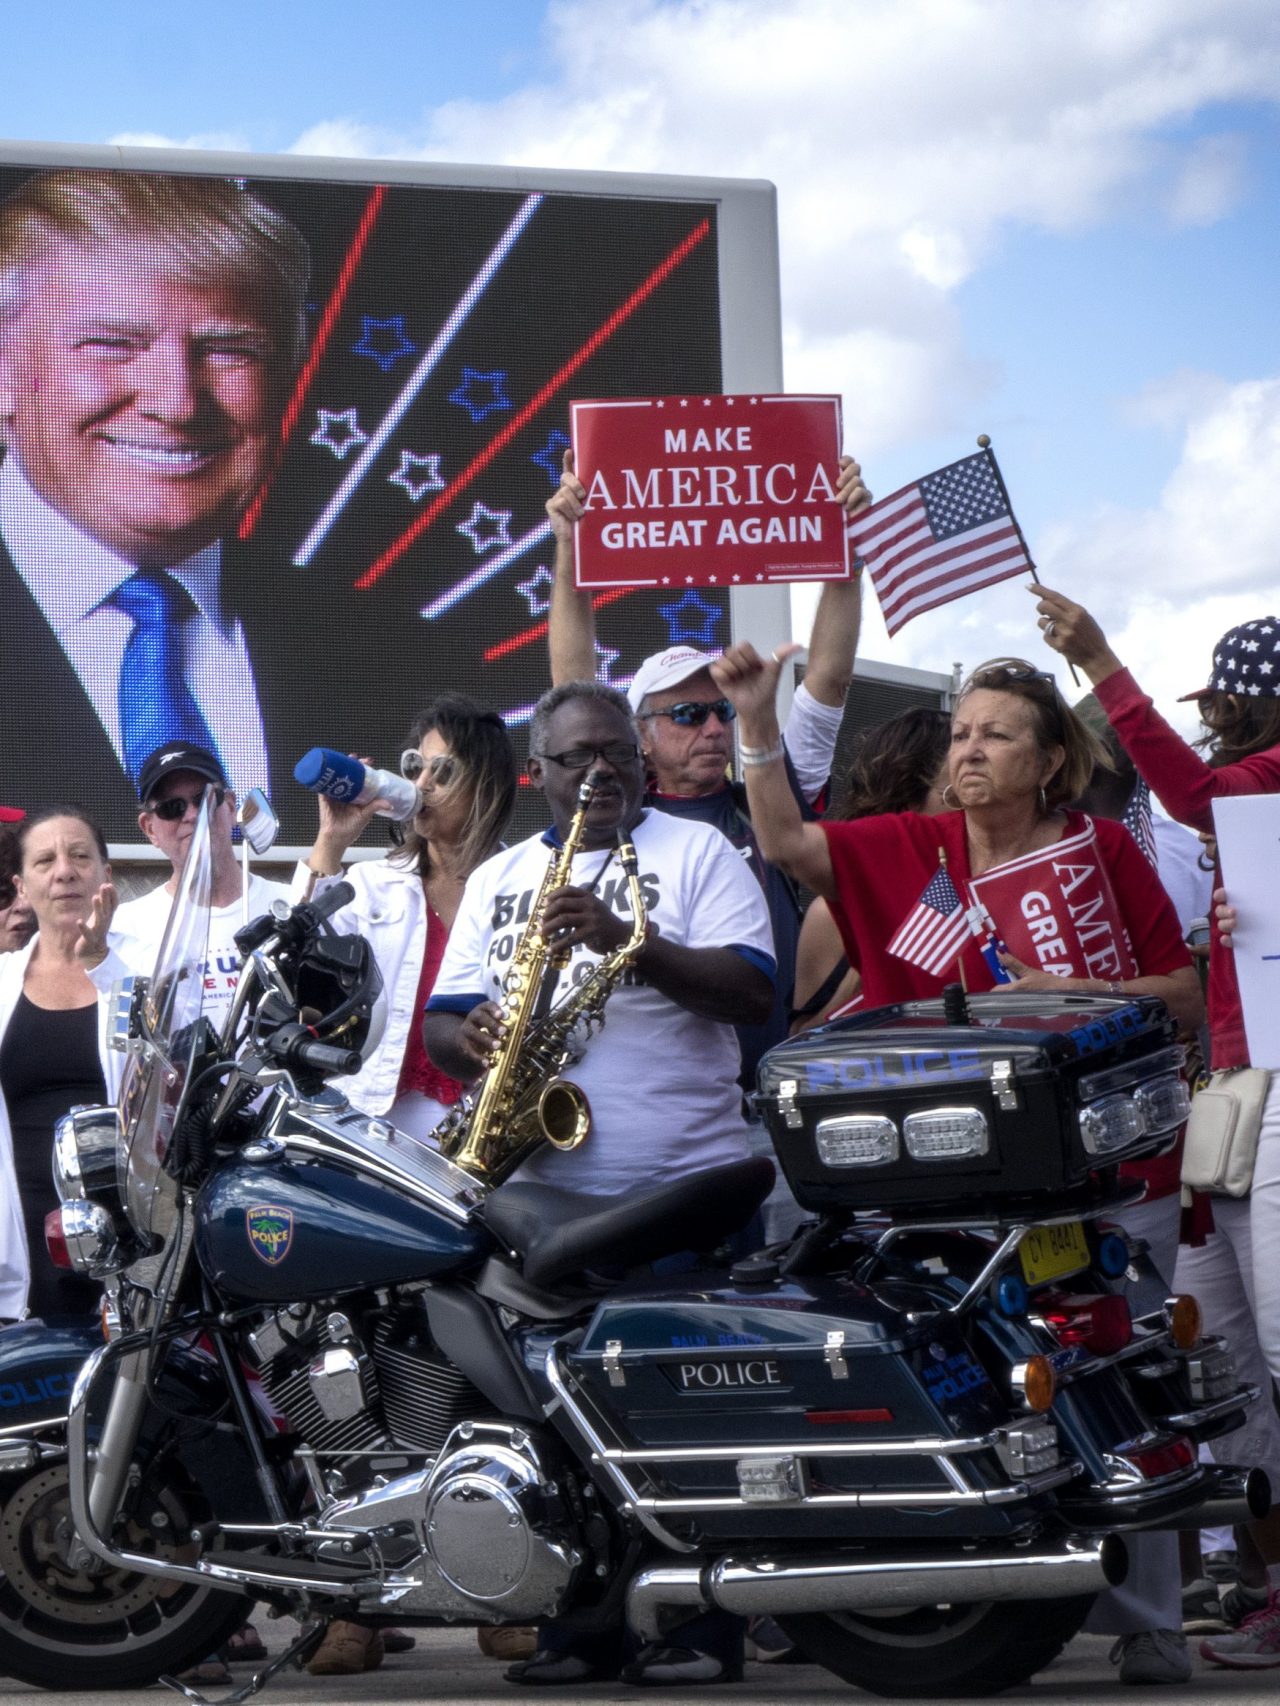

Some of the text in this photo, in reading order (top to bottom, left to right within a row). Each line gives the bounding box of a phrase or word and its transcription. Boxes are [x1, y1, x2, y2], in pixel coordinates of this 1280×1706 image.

[664, 426, 752, 453] MAKE
[583, 462, 840, 511] AMERICA
[600, 515, 822, 549] GREAT AGAIN
[1021, 890, 1074, 978] GREA
[806, 1049, 985, 1093] POLICE
[251, 1229, 288, 1243] POLICE
[680, 1360, 781, 1388] POLICE
